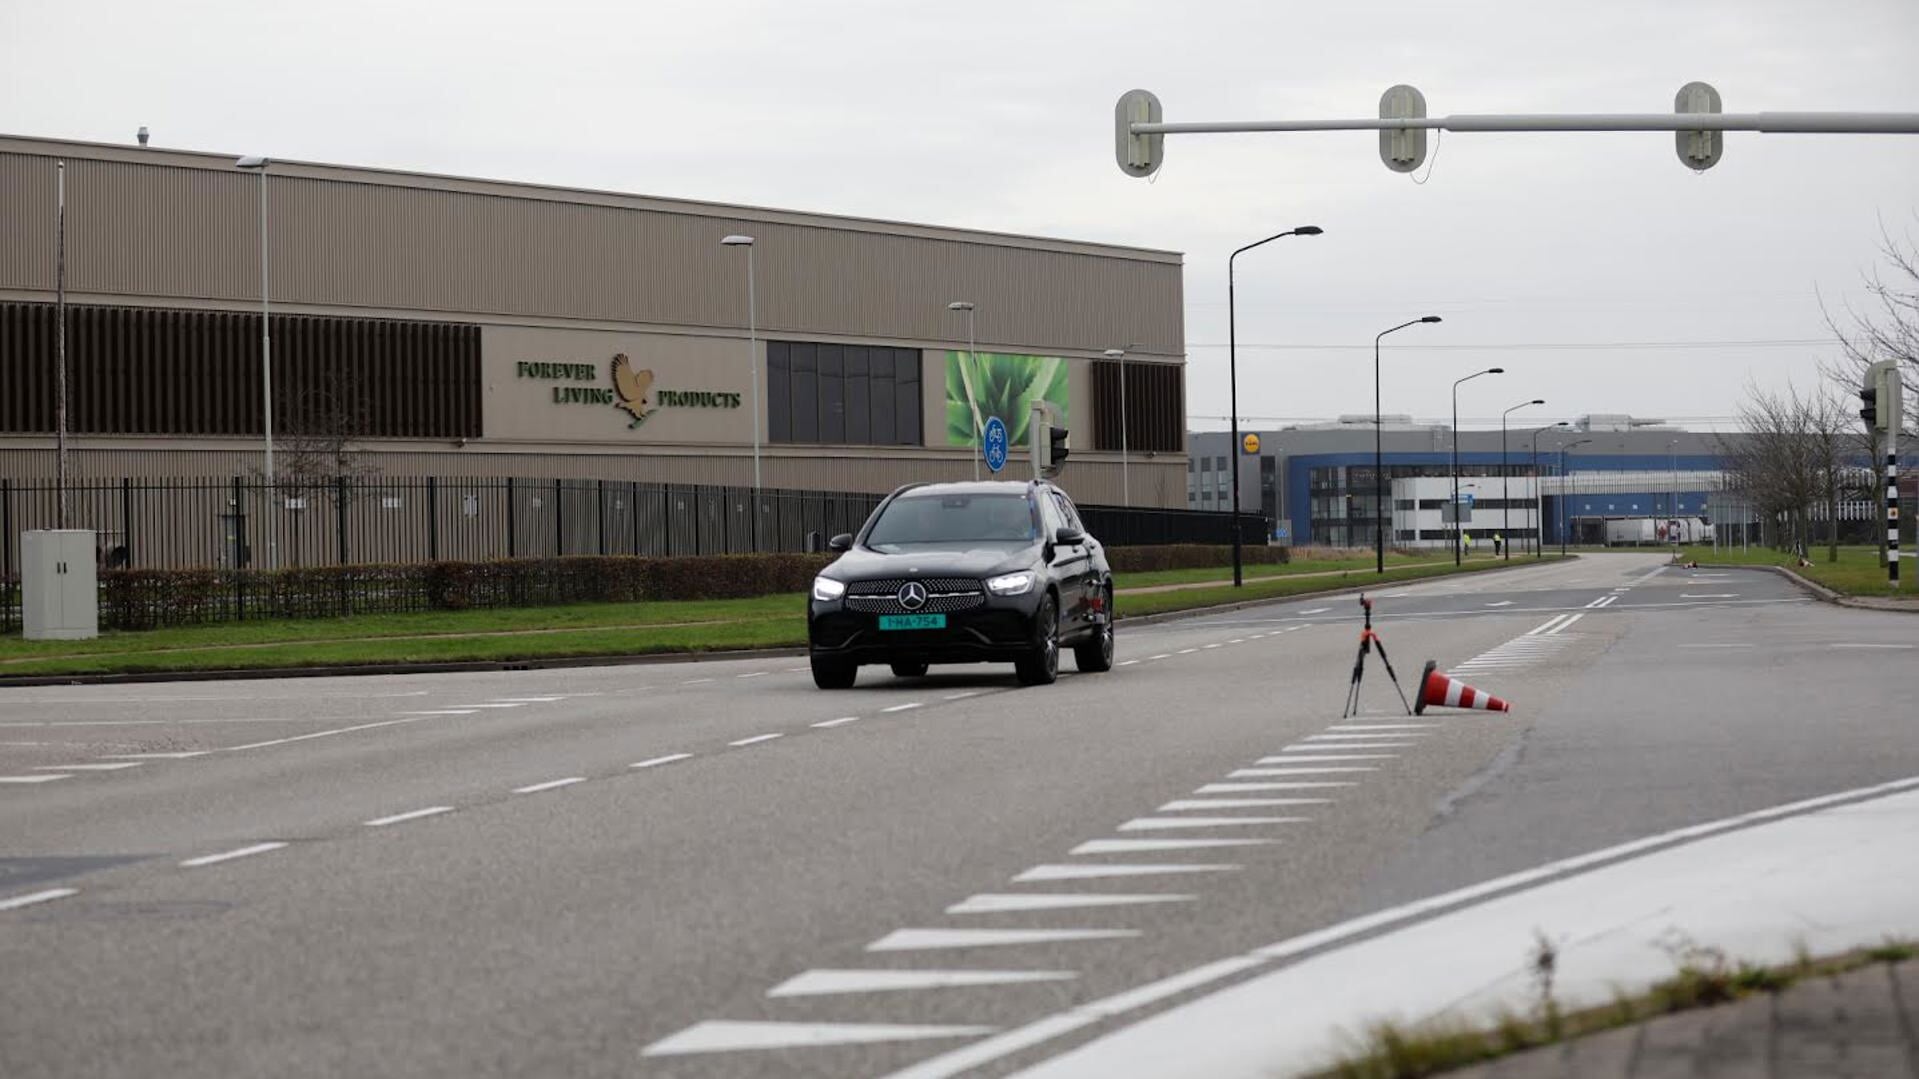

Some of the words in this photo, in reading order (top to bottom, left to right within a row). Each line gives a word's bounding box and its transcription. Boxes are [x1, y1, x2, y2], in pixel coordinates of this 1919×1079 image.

[517, 361, 595, 380] FOREVER
[553, 386, 613, 405] LIVING
[657, 390, 741, 408] PRODUCTS
